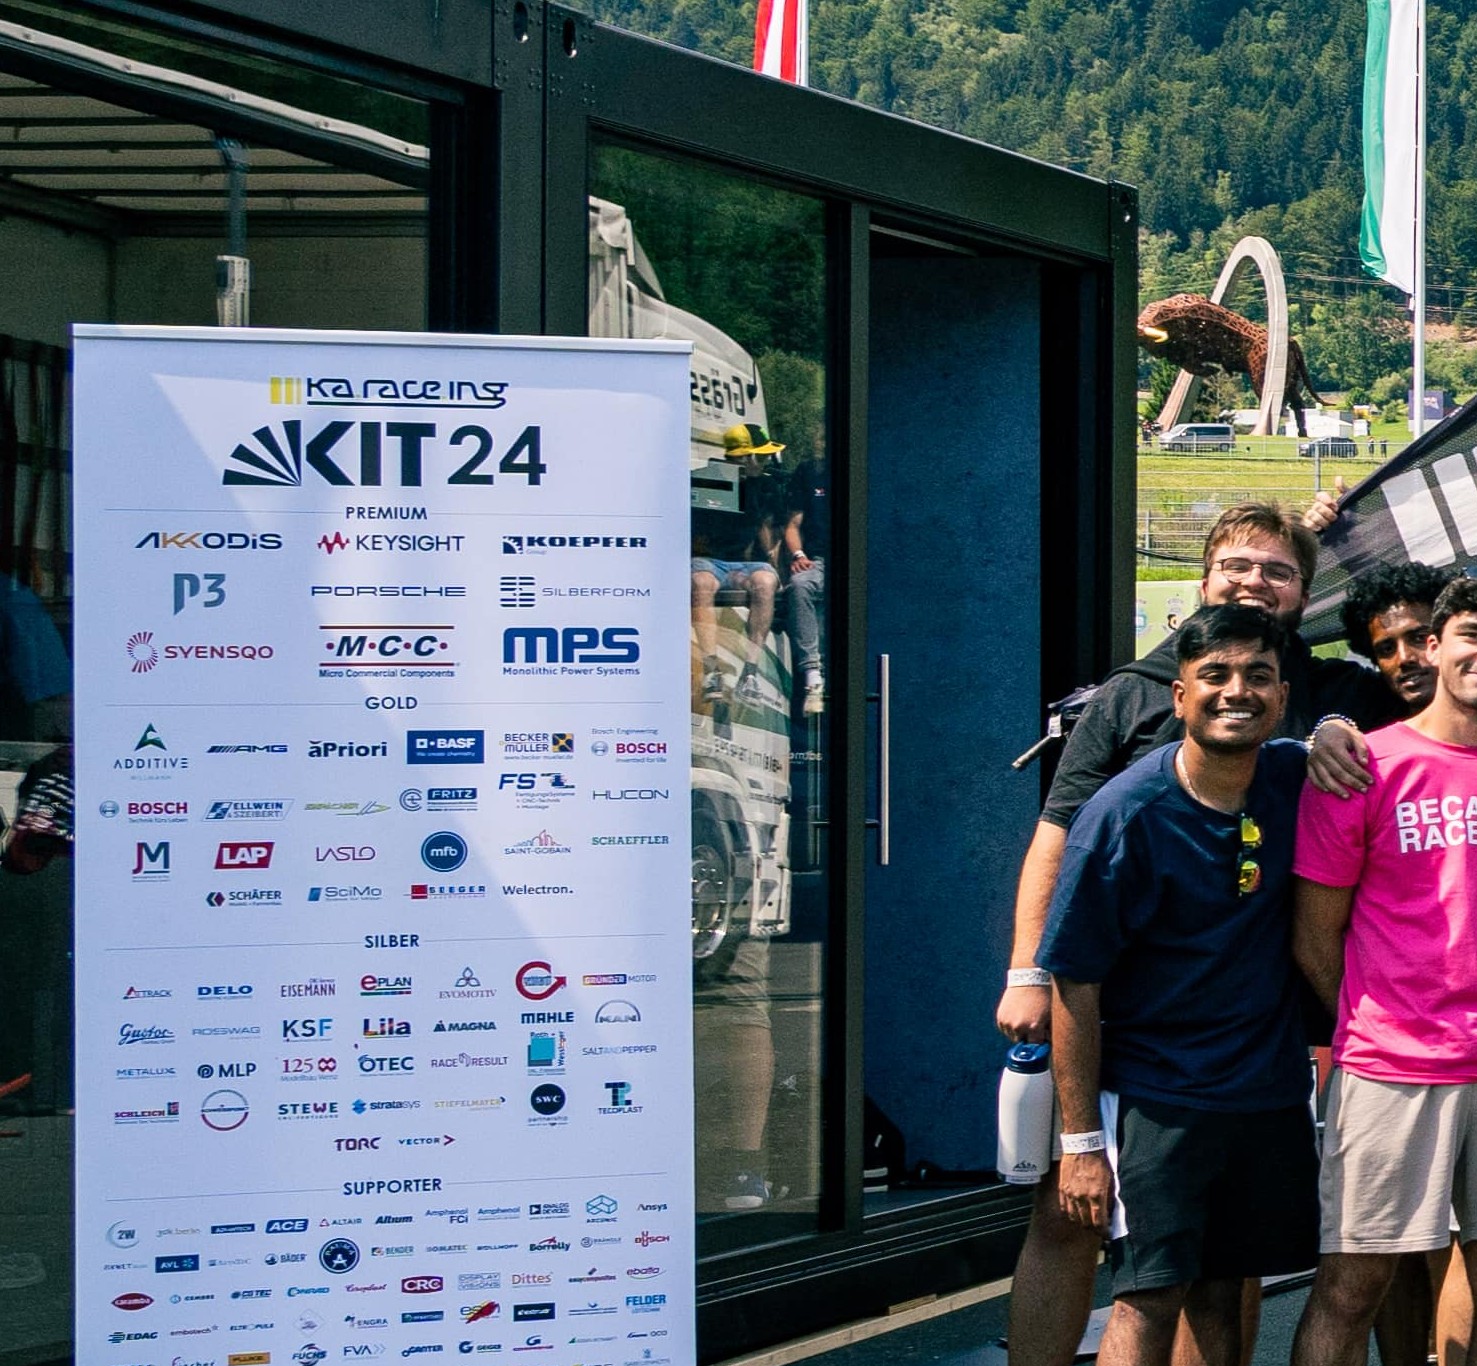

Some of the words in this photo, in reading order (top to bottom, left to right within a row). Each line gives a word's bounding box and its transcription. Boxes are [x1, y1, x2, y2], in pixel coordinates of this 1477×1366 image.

[305, 420, 436, 487] KIT
[447, 424, 547, 487] 24
[345, 506, 428, 521] PREMIUM
[356, 534, 465, 553] KEYSIGHT
[526, 536, 647, 549] KOEPFER
[173, 572, 226, 616] P3
[311, 586, 466, 597] PORSCHE
[542, 587, 651, 598] SILBERFORM
[164, 644, 274, 661] SYENSQO
[319, 669, 343, 678] Micro
[345, 669, 398, 678] Commercial
[399, 669, 455, 680] Components
[503, 666, 557, 676] Monolithic
[560, 666, 594, 676] Power
[596, 667, 640, 677] Systems
[365, 696, 418, 710] GOLD
[437, 738, 476, 748] BASF
[504, 733, 549, 742] BECKER
[235, 744, 288, 753] AMG
[615, 742, 667, 754] BOSCH
[113, 758, 189, 769] ADDITIVE
[499, 773, 536, 789] FS
[431, 790, 473, 799] FRITZ
[592, 790, 669, 800] HUCON
[128, 802, 188, 814] BOSCH
[234, 801, 283, 811] ELLWEIN
[234, 810, 280, 819] SZEIBERT
[592, 836, 669, 846] SCHAEFFLER
[223, 847, 267, 864] LAP
[430, 845, 458, 857] mfb
[504, 847, 571, 855] SAINT-GOBAIN
[229, 889, 282, 901] SCHÄFER
[324, 886, 382, 897] SciMo
[429, 885, 486, 894] SEEGER
[364, 934, 420, 949] SILBER
[197, 985, 253, 996] DELO
[281, 984, 336, 998] EISEMANN
[439, 989, 497, 999] EVOMOTIV
[521, 1011, 575, 1024] MAHLE
[283, 1018, 333, 1038] KSF
[448, 1021, 497, 1032] MAGNA
[282, 1058, 313, 1073] 125
[431, 1057, 458, 1068] RACE
[471, 1056, 508, 1067] RESULT
[218, 1063, 256, 1078] MLP
[278, 1102, 338, 1115] STEWE
[333, 1136, 381, 1151] TORC
[399, 1137, 440, 1145] VECTOR
[343, 1178, 442, 1196] SUPPORTER
[636, 1203, 667, 1212] Ansys
[269, 1220, 305, 1232] ACE
[160, 1260, 180, 1269] AVL
[404, 1278, 442, 1290] CRC
[511, 1273, 551, 1284] Dittes
[626, 1294, 667, 1306] FELDER
[125, 1332, 158, 1341] EDAC
[292, 1350, 327, 1361] FUCHS
[343, 1345, 371, 1356] FVA
